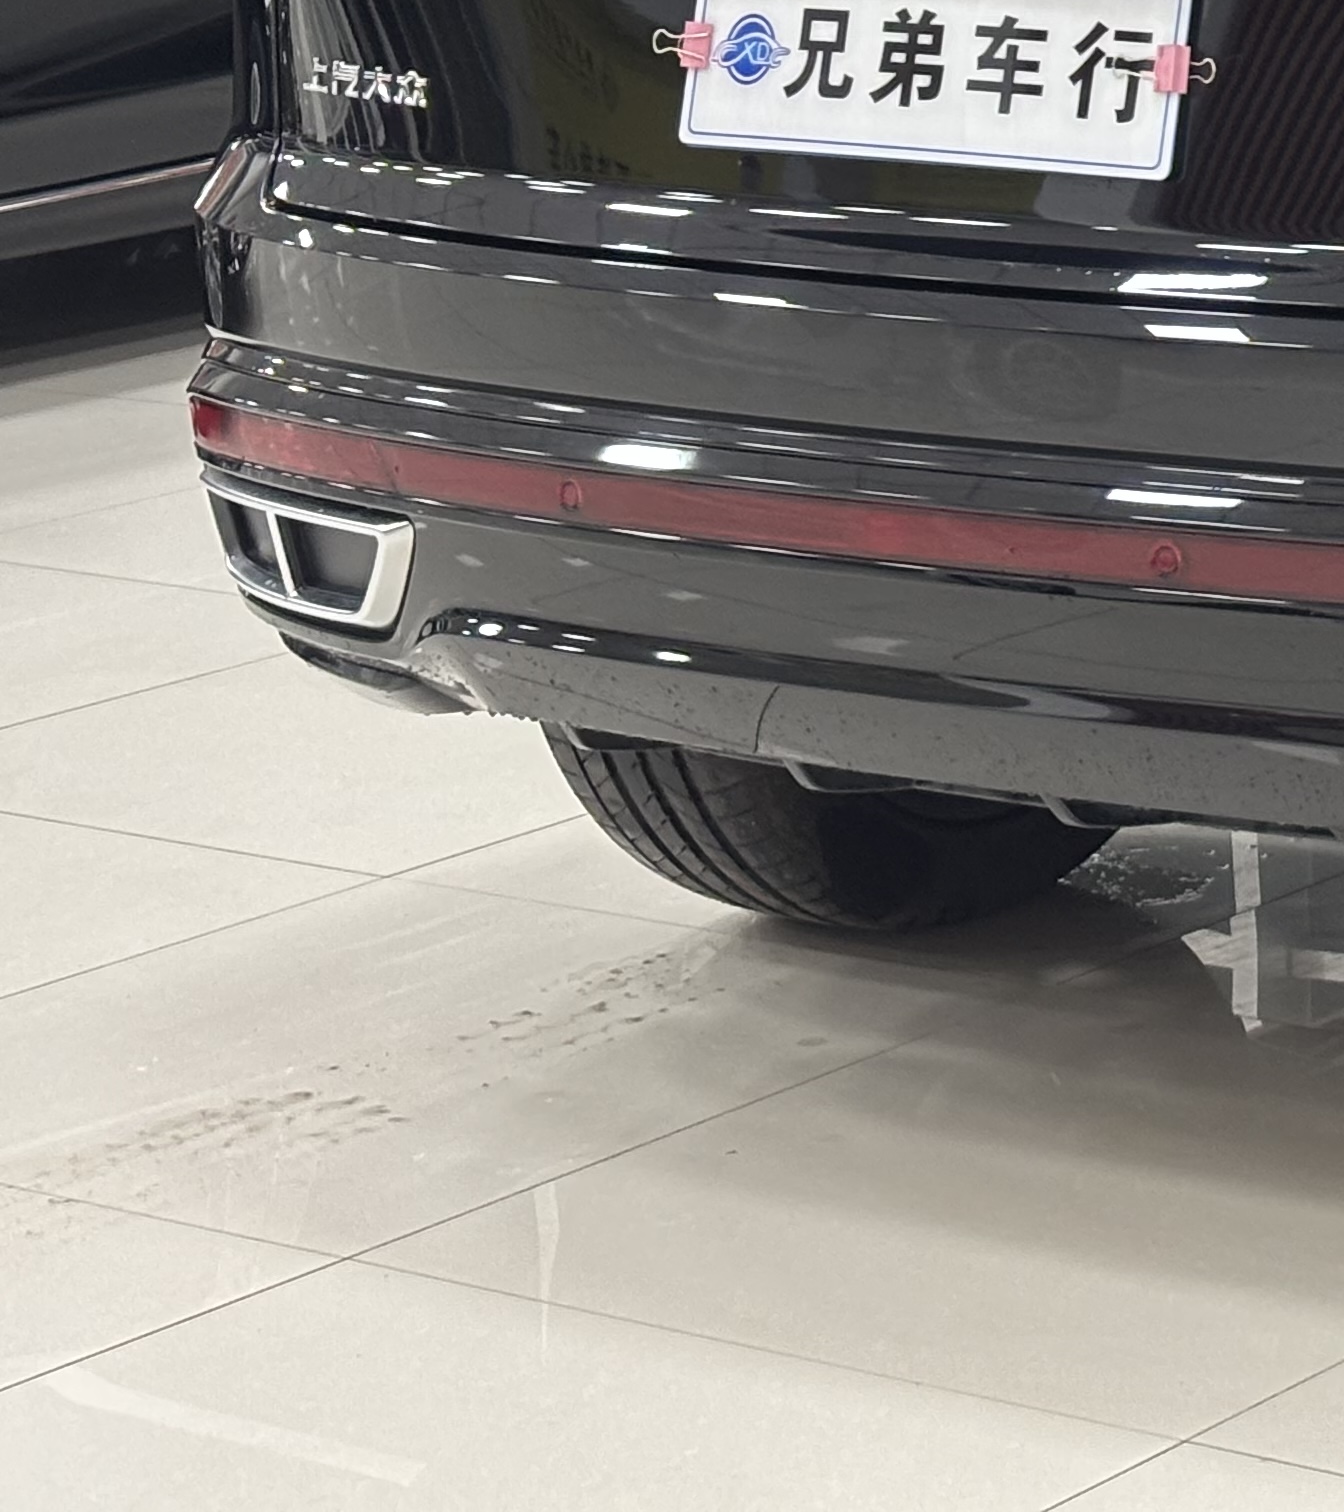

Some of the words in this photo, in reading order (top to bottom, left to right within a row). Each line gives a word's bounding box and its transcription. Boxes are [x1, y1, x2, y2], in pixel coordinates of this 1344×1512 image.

[302, 56, 428, 108] 上汽大众
[784, 7, 1153, 123] 兄弟车行
